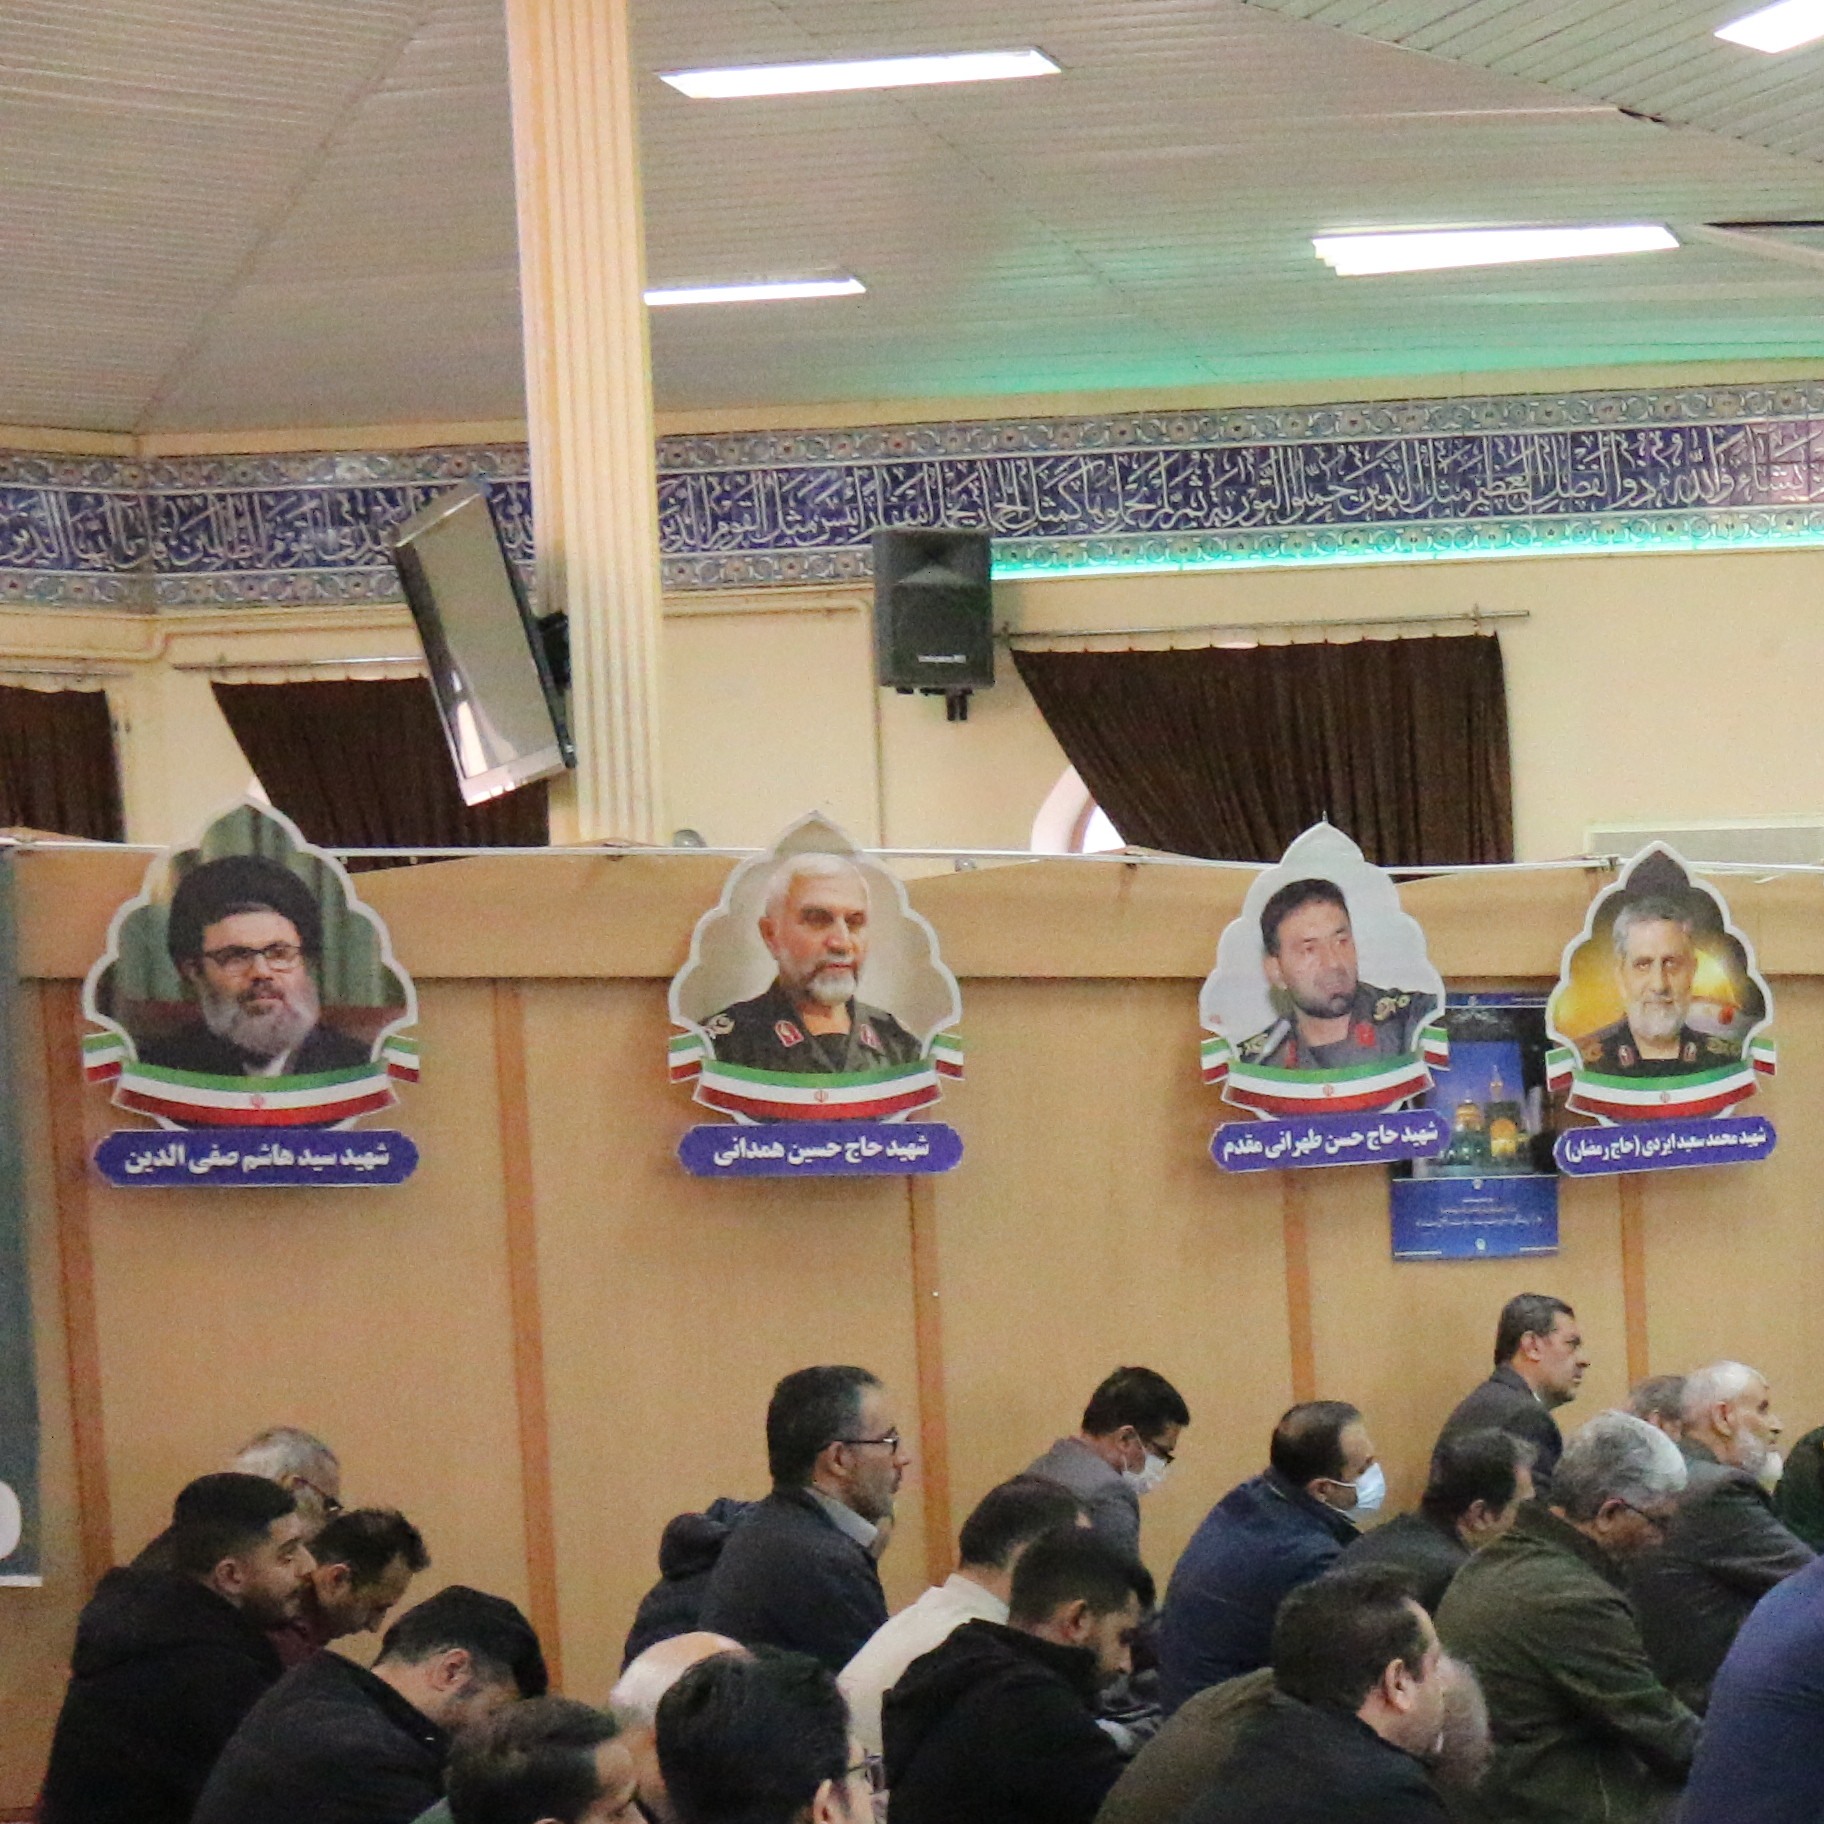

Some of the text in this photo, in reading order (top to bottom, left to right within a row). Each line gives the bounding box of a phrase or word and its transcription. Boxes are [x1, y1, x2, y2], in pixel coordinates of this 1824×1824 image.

[713, 1134, 930, 1168] شهید حاج حسین همدانی
[1223, 1120, 1440, 1163] شهید حاج حسن طهرانی مقدم
[1564, 1138, 1610, 1164] رمضان)
[1609, 1134, 1641, 1160] (حاج
[1676, 1135, 1706, 1154] سعید
[1706, 1132, 1738, 1149] محمد
[1739, 1127, 1768, 1149] شهید
[124, 1142, 391, 1175] شهید سید هاشم صفی الدین
